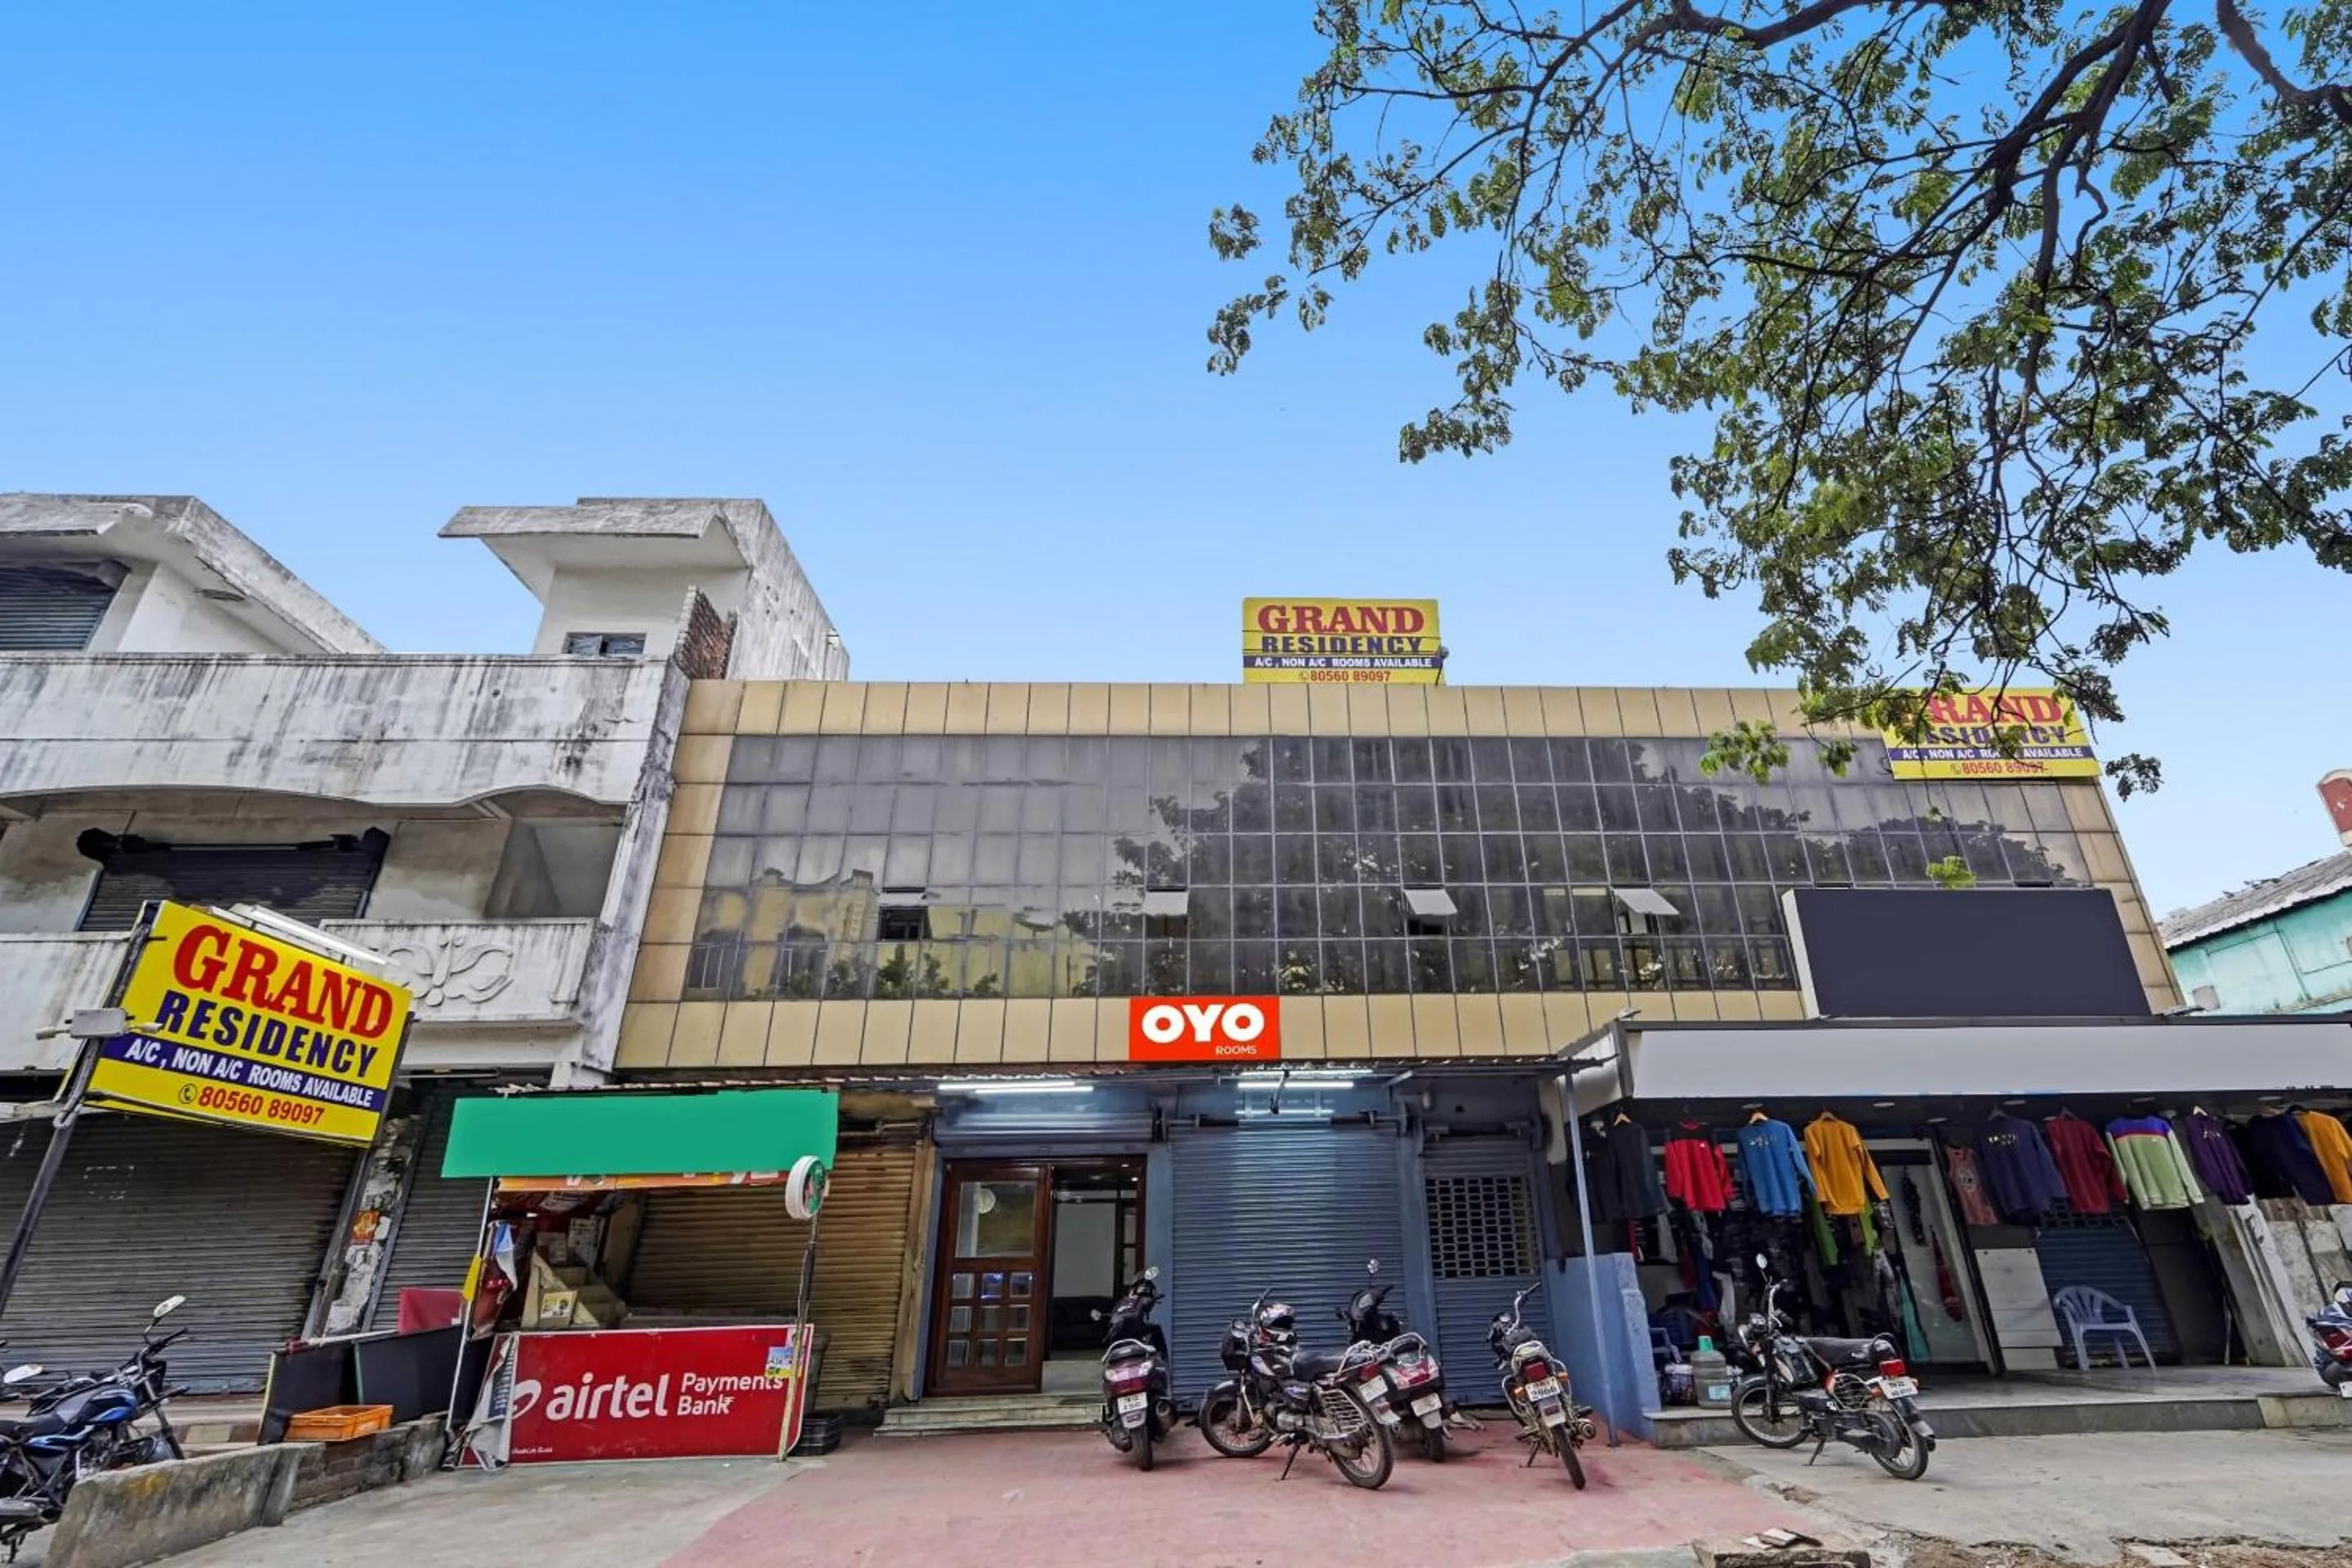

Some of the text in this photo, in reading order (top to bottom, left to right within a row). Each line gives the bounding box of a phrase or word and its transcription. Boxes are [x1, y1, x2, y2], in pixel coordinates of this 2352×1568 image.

[1258, 604, 1424, 634] GRAND
[1262, 636, 1422, 653] RESIDENCY
[1281, 657, 1305, 667] NON
[1309, 657, 1326, 667] A/C
[1332, 657, 1371, 667] ROOMS
[1374, 657, 1432, 668] AVAILABLE
[1310, 670, 1391, 681] 80560 89097
[1903, 694, 2062, 724] RAND
[1928, 749, 1953, 760] NON
[2024, 748, 2084, 759] AVAILABLE
[174, 924, 393, 1039] GRAND
[155, 989, 377, 1078] RESIDENCY
[1142, 1003, 1264, 1043] OYO
[1215, 1045, 1257, 1055] ROOMS
[171, 1047, 214, 1075] NON
[212, 1058, 243, 1080] A/C
[247, 1064, 303, 1093] ROOMS
[301, 1076, 374, 1107] AVAILABLE
[198, 1085, 325, 1125] 80560 89097
[546, 1371, 670, 1421] airtel
[681, 1373, 784, 1396] Payments
[677, 1394, 733, 1416] Bank
